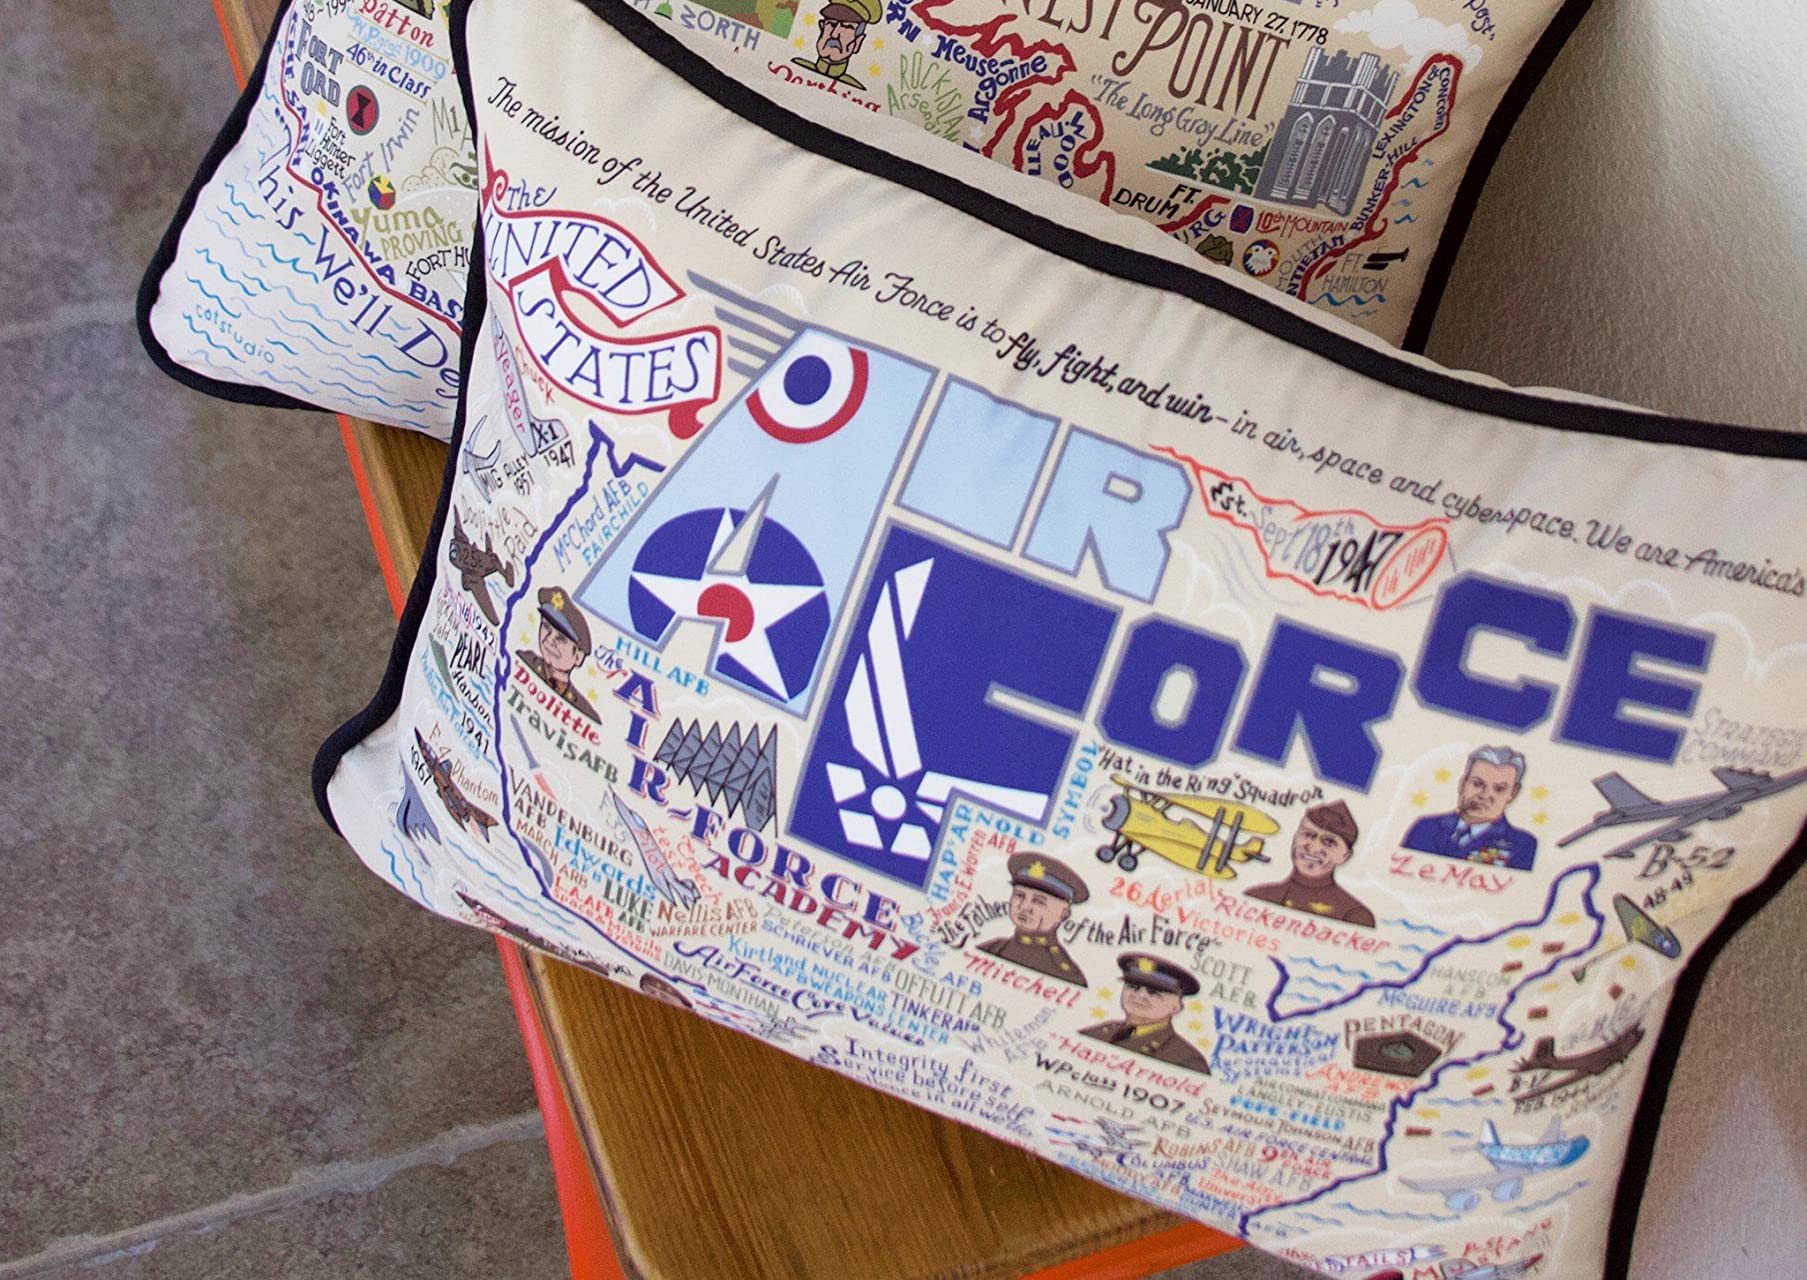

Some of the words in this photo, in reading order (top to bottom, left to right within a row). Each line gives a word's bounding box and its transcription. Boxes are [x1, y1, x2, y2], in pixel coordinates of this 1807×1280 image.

[1290, 19, 1330, 46] 1778
[346, 42, 376, 66] 46th
[374, 57, 388, 77] in
[388, 66, 432, 99] Class
[402, 44, 448, 81] 1909
[967, 54, 1048, 125] Argonne
[1433, 66, 1451, 131] CONCORD
[1126, 92, 1177, 137] Long
[1175, 106, 1219, 148] Gray
[1372, 78, 1433, 161] LEXINGTON
[304, 139, 346, 180] Liggett
[343, 151, 374, 203] Fort
[379, 107, 421, 172] Irwin
[1112, 187, 1180, 219] DRUM
[1168, 183, 1202, 206] FT.
[1349, 169, 1391, 232] BUNKER
[1387, 136, 1419, 163] HILL
[311, 167, 396, 286] OKINAWA
[350, 206, 443, 249] Yuma
[380, 220, 463, 262] PROVING
[1280, 214, 1350, 239] MOUNTAIN
[314, 223, 394, 337] We'll
[405, 248, 452, 281] FORT
[484, 212, 652, 309] UNITED
[1320, 274, 1389, 294] HAMILTON
[195, 303, 276, 364] catstudio
[488, 76, 522, 119] The
[521, 105, 602, 165] mission
[596, 157, 642, 186] of
[632, 171, 675, 205] the
[674, 185, 760, 249] United
[753, 235, 826, 279] States
[827, 260, 872, 293] Air
[874, 271, 955, 322] Force
[956, 307, 977, 332] is
[980, 316, 1007, 344] to
[997, 333, 1041, 372] fly,
[1262, 428, 1305, 461] air,
[1309, 445, 1383, 485] space
[1389, 472, 1437, 505] and
[1441, 488, 1579, 544] cyberspace.
[1584, 517, 1634, 554] We
[1633, 538, 1681, 569] are
[1682, 547, 1807, 598] America's
[517, 290, 710, 405] STATES
[531, 421, 561, 449] X-1
[544, 440, 576, 468] 1947
[553, 497, 607, 573] McChord
[602, 478, 633, 519] AFB
[573, 326, 1200, 722] AIR
[581, 482, 649, 567] FAIRCHILD
[1210, 480, 1249, 518] Est.
[1313, 529, 1404, 594] 1947
[450, 630, 488, 680] PEARL
[616, 636, 663, 672] HILL
[666, 667, 710, 697] AFB
[507, 684, 579, 763] Travis
[514, 659, 603, 747] Doolittle
[784, 516, 1718, 900] FORCE
[461, 711, 490, 755] 1941
[451, 757, 499, 807] Phantom
[1052, 741, 1101, 841] SYMBOL
[1134, 763, 1151, 786] in
[1155, 767, 1182, 790] the
[1232, 776, 1326, 810] Squadron
[508, 764, 634, 869] VANDENBURG
[513, 792, 549, 830] AFB
[515, 818, 560, 867] MARCH
[553, 825, 657, 902] Edwards
[986, 832, 1018, 856] AFB
[1634, 840, 1737, 880] B-52
[689, 803, 902, 935] FORCE
[1108, 875, 1143, 904] 26
[602, 878, 654, 920] LUKE
[656, 899, 723, 925] Nellis
[723, 897, 760, 922] AFB
[704, 846, 922, 962] ACADEMY
[960, 894, 1012, 939] Father
[1060, 918, 1085, 945] of
[1085, 918, 1115, 948] the
[1117, 914, 1144, 946] Air
[1215, 887, 1392, 956] Rickenbacker
[649, 922, 709, 938] WARFARE
[707, 922, 760, 937] CENTER
[760, 918, 856, 968] SCHRIEVER
[857, 959, 894, 985] AFB
[1175, 904, 1281, 954] Victories
[728, 934, 808, 973] Kirtland
[810, 961, 890, 1003] NUCLEAR
[963, 950, 1083, 1010] Mitchell
[1190, 952, 1254, 988] SCOTT
[890, 988, 954, 1029] TINKER
[968, 1000, 1011, 1030] AFB
[1342, 1012, 1466, 1058] PENTAGON
[844, 1033, 950, 1077] Integrity
[955, 1057, 1014, 1100] first
[1104, 1056, 1208, 1097] Arnold
[1035, 1079, 1137, 1122] ARNOLD
[1121, 1083, 1188, 1116] 1907
